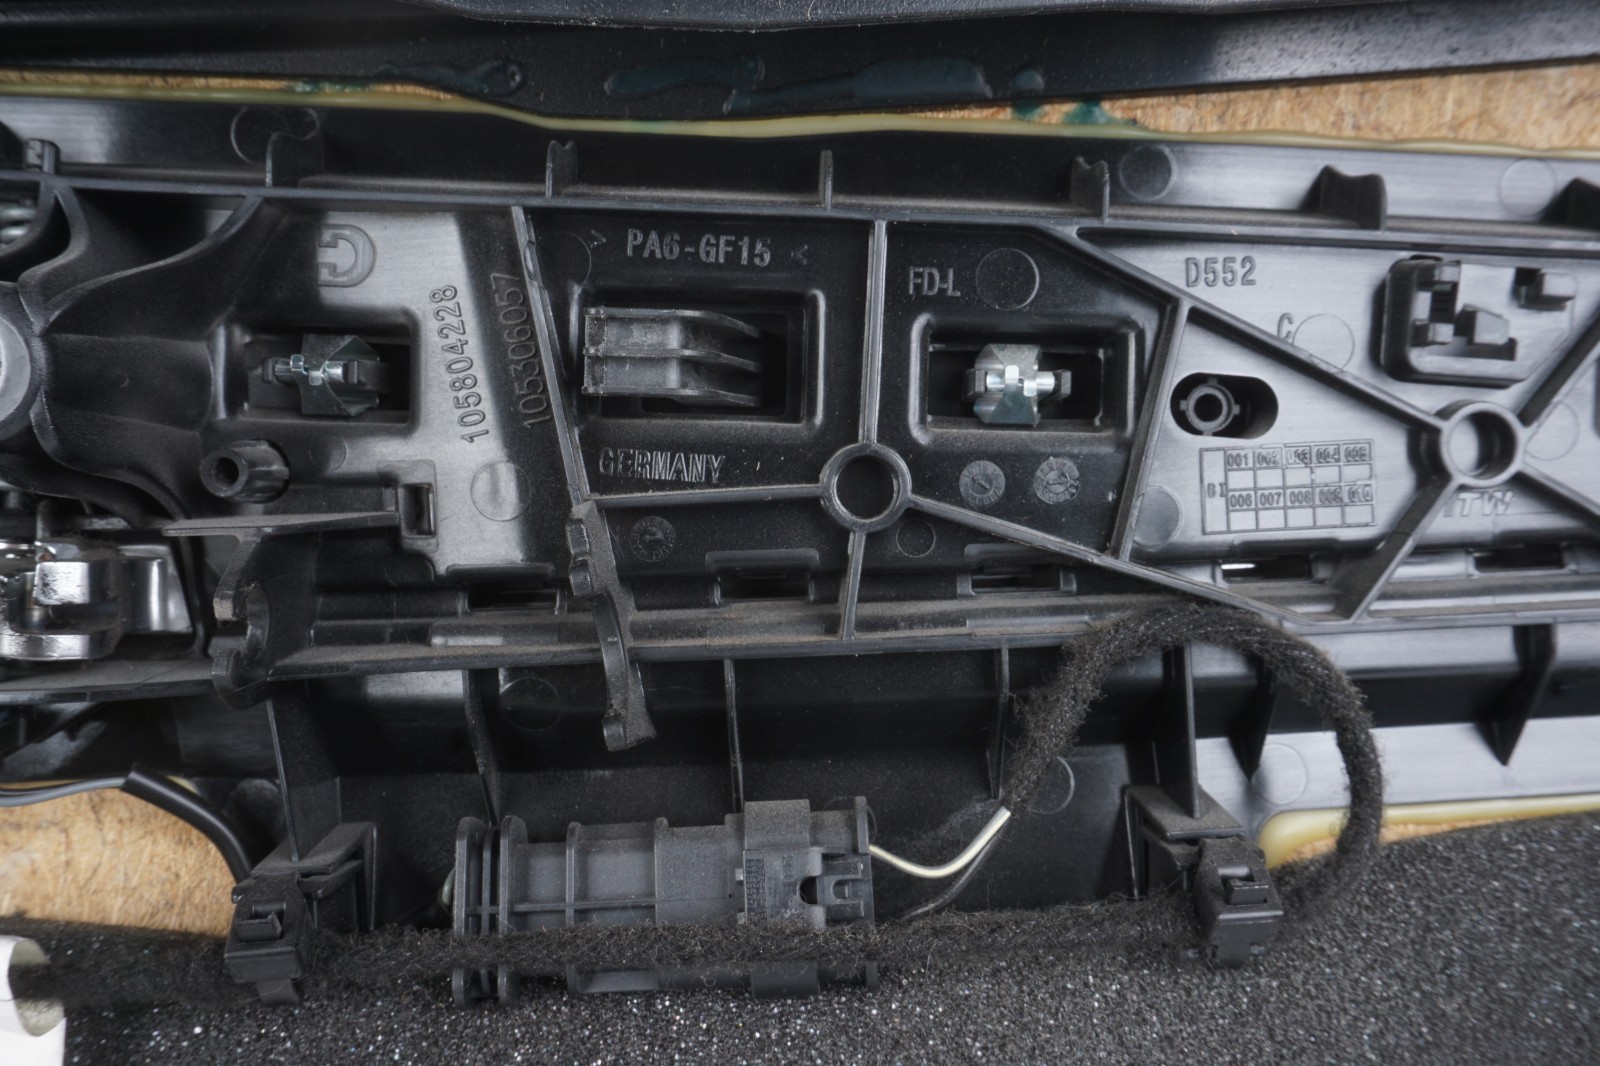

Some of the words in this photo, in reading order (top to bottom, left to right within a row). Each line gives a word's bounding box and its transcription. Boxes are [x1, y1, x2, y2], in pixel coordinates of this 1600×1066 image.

[626, 229, 771, 267] PA6-GF15
[908, 266, 961, 297] FD-L
[1185, 256, 1257, 287] D552
[430, 284, 490, 444] 105804228
[490, 272, 552, 430] 105306057
[599, 448, 726, 483] GERMANY
[1226, 453, 1249, 467] 001
[1257, 450, 1280, 466] 002
[1229, 493, 1253, 508] 006
[1260, 491, 1283, 507] 007
